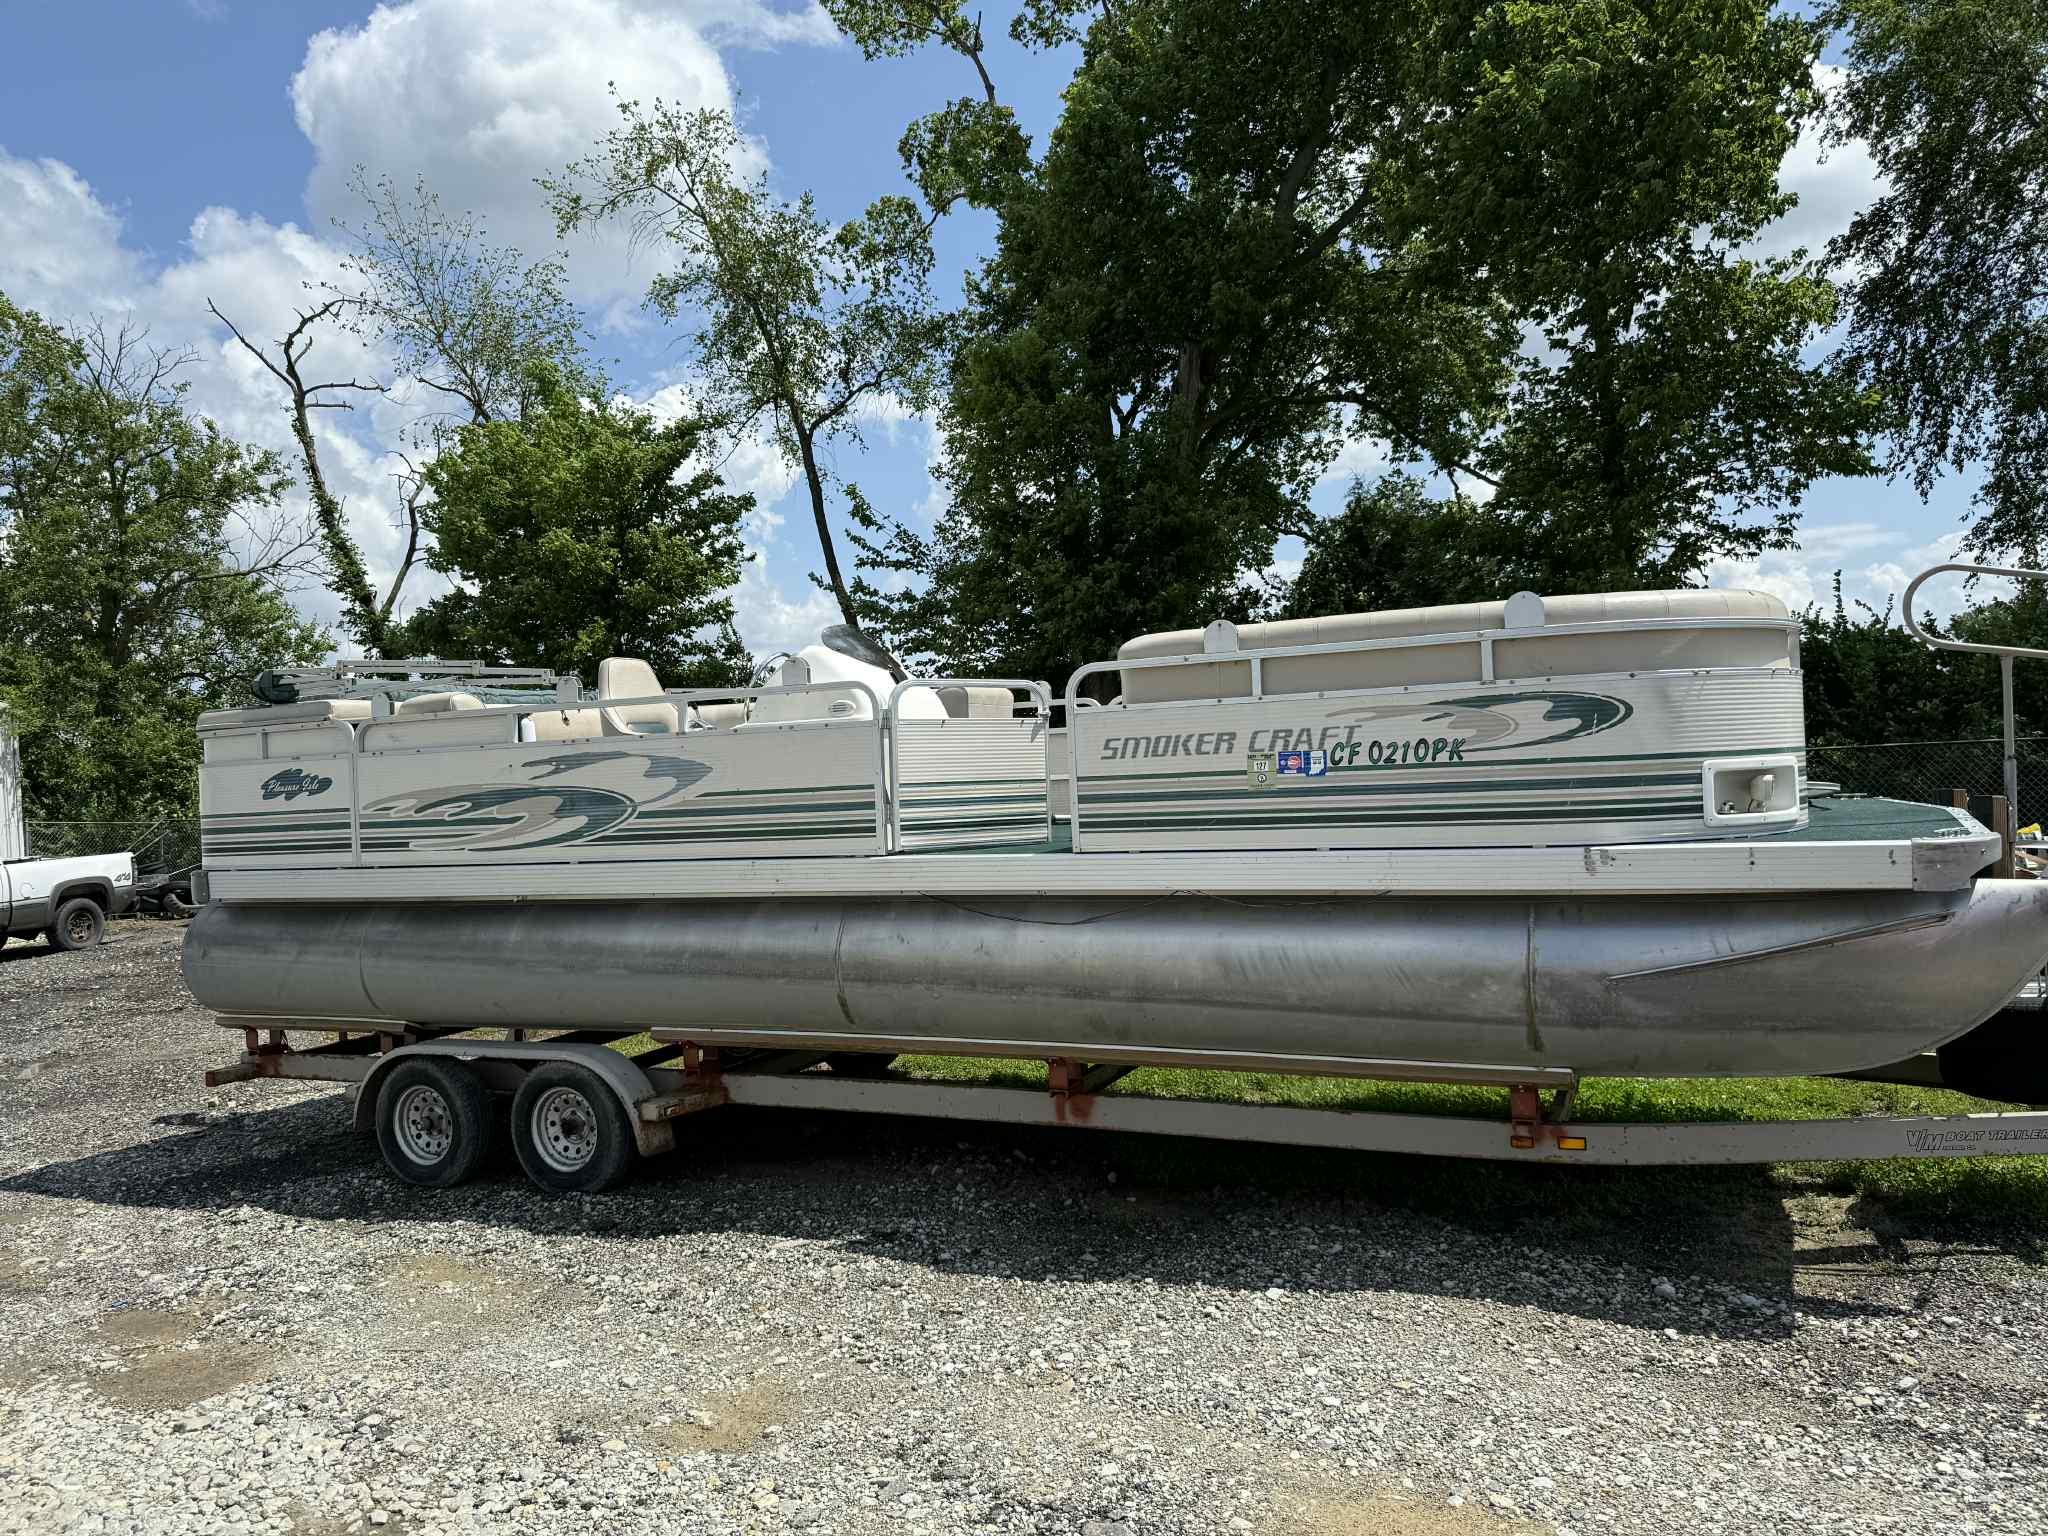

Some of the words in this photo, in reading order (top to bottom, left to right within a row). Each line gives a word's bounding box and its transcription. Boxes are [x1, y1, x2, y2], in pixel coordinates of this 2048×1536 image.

[1101, 731, 1236, 760] SMOKER
[1249, 725, 1362, 752] CRAFT
[1330, 741, 1361, 766] CF
[1368, 738, 1467, 764] 0210PK
[1944, 1131, 1985, 1141] BOAT
